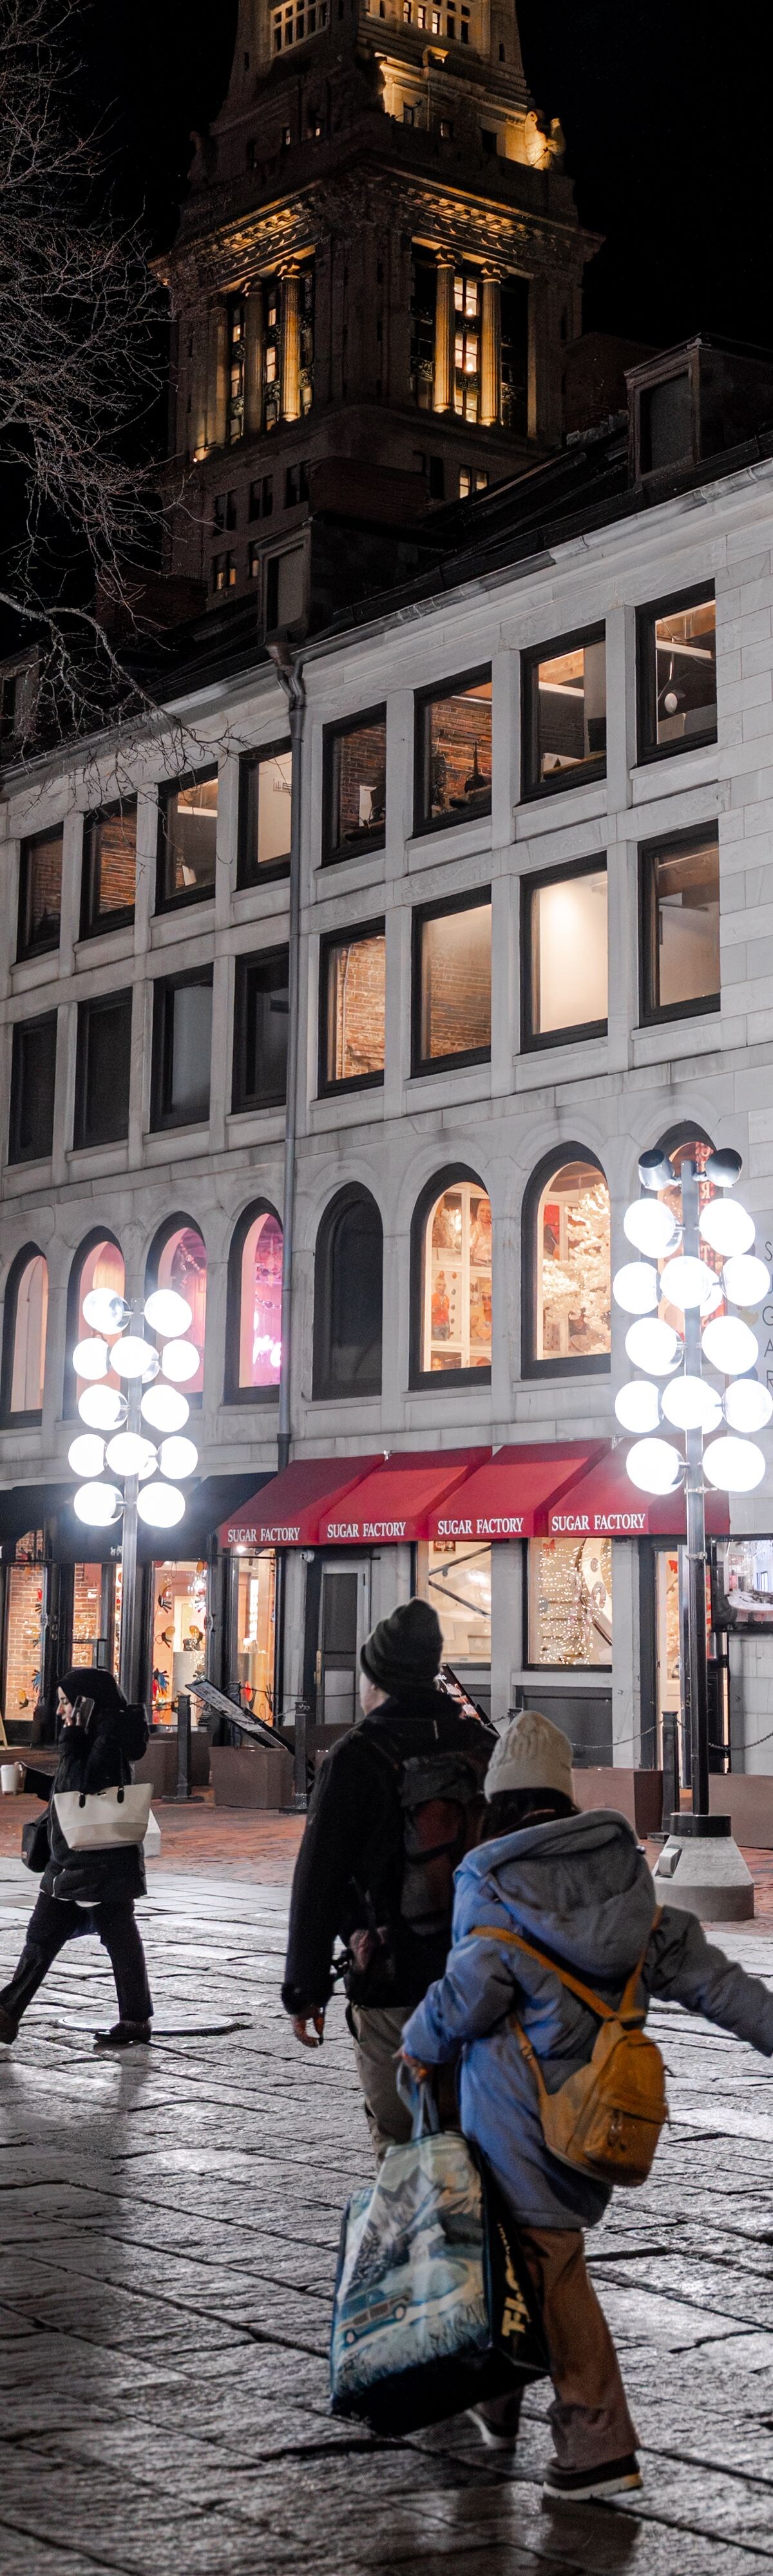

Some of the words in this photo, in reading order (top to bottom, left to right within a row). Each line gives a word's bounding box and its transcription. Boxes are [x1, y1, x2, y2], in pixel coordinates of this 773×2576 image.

[327, 1524, 359, 1537] SUGAR
[363, 1522, 406, 1537] FACTORY
[438, 1520, 473, 1535] SUGAR
[477, 1518, 524, 1533] FACTORY
[552, 1515, 590, 1531] SUGAR
[594, 1513, 645, 1530] FACTORY
[228, 1529, 257, 1543] SUGAR
[260, 1528, 300, 1541] FACTORY
